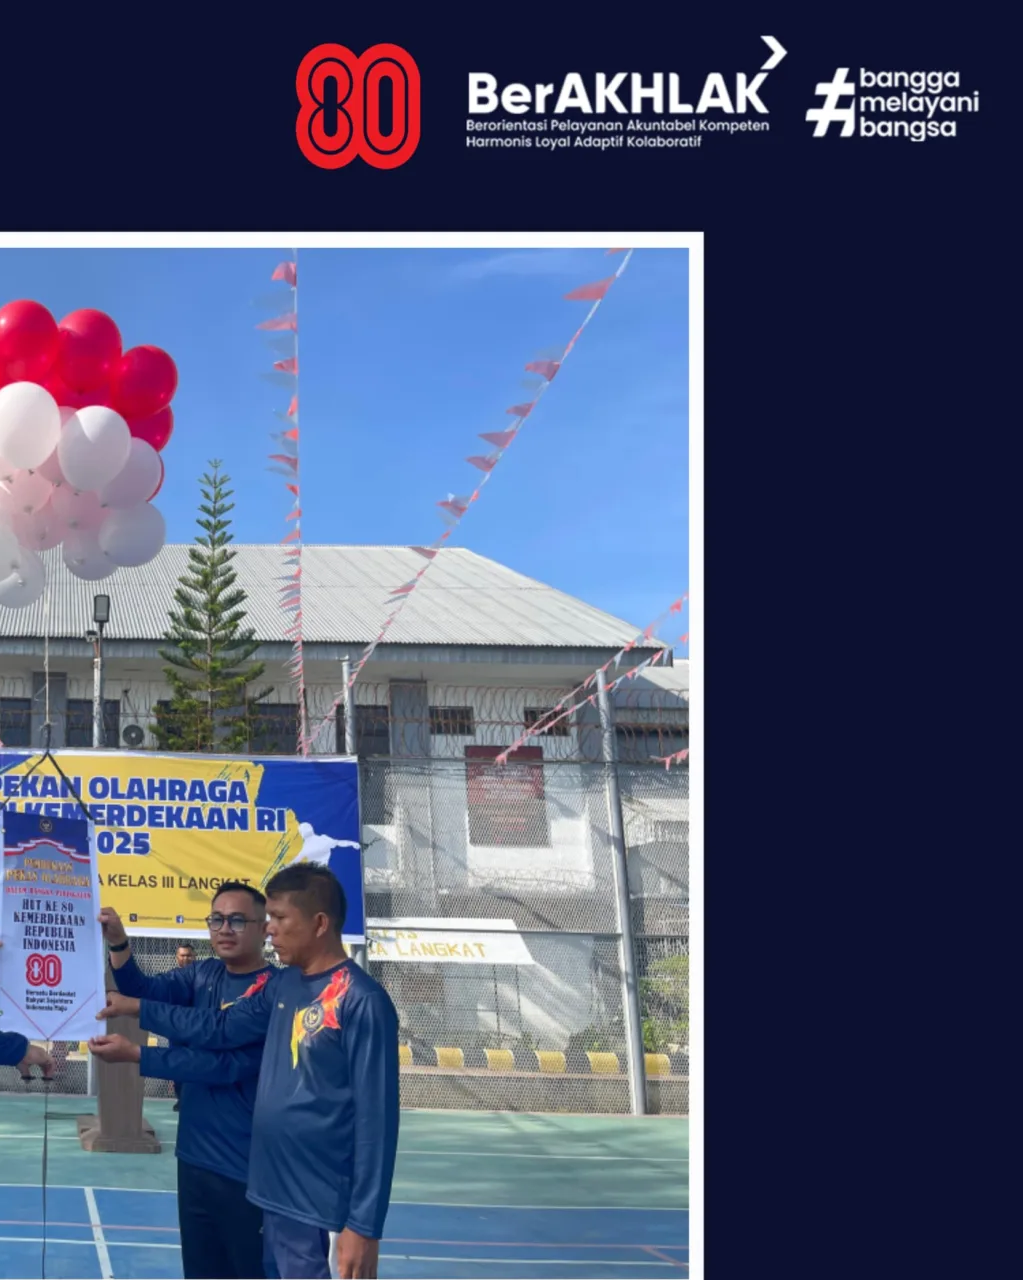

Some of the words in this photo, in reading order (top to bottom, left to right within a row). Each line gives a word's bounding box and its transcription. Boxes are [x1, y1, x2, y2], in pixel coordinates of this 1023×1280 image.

[88, 776, 249, 804] OLAHRAGA
[256, 807, 287, 833] RI
[95, 831, 151, 856] 025
[107, 874, 158, 889] KELAS
[161, 876, 175, 889] III
[22, 898, 42, 911] HUT
[45, 900, 57, 912] KE
[61, 901, 74, 913] 80
[13, 911, 86, 927] KEMERDEKAAN
[24, 925, 75, 939] REPUBLIK
[22, 938, 76, 952] INDONESIA
[395, 942, 486, 958] LANGKAT
[25, 952, 63, 988] 80
